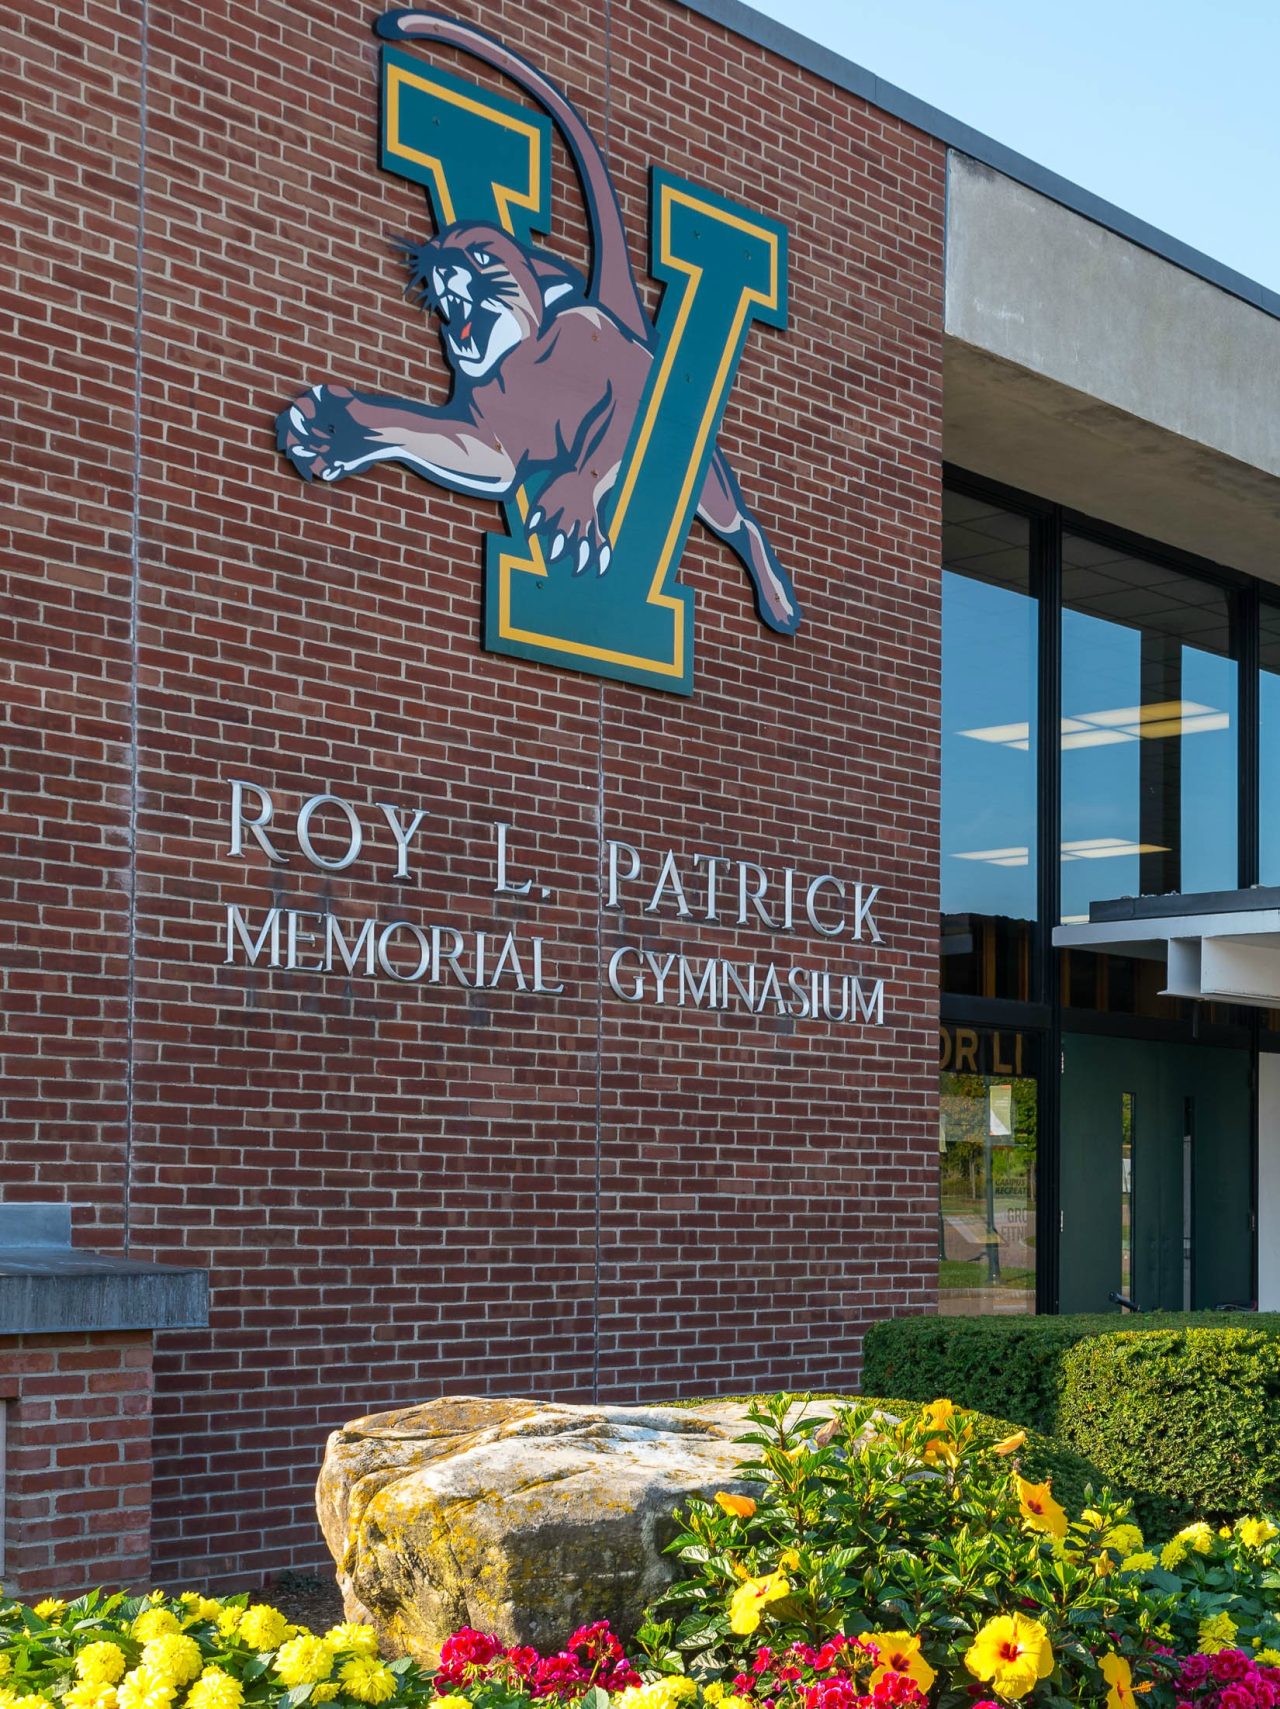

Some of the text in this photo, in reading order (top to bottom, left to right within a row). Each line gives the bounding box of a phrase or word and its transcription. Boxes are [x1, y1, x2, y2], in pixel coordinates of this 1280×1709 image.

[226, 778, 887, 945] ROY L. PATRICK
[223, 902, 885, 1026] MEMORIAL GYMNASIUM
